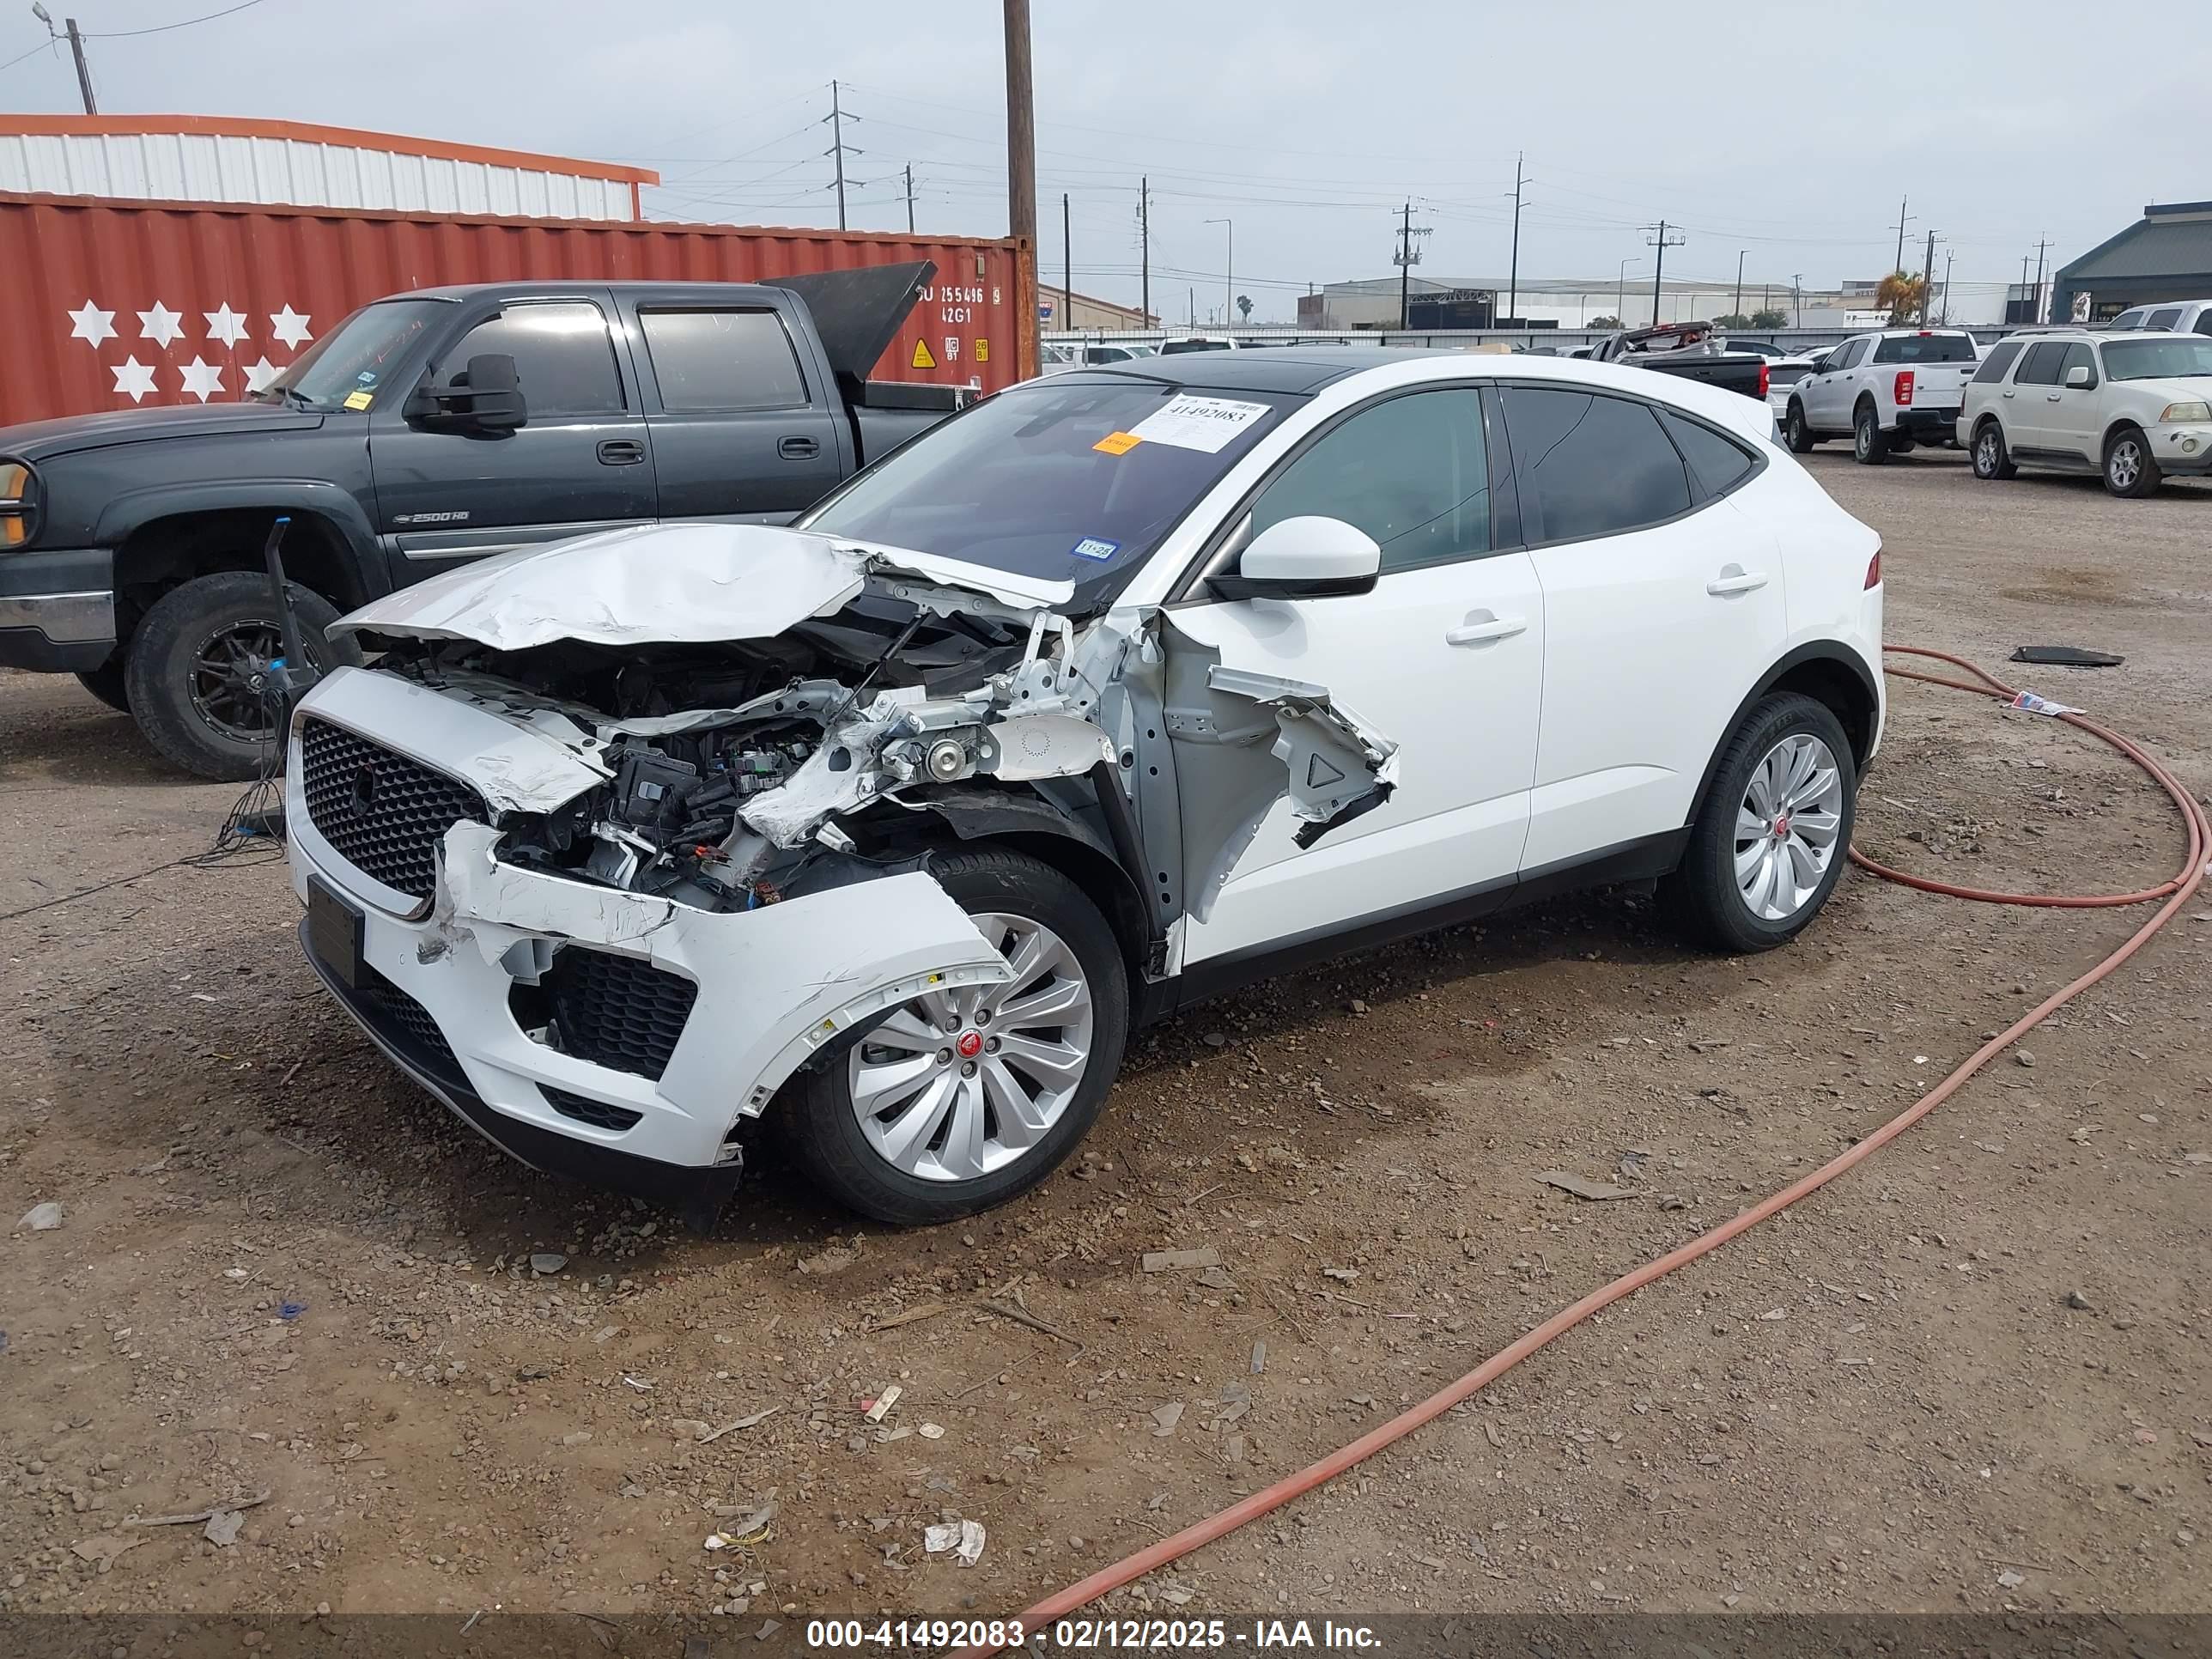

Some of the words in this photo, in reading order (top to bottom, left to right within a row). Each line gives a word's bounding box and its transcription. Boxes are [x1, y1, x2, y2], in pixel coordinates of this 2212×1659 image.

[942, 307, 971, 323] 42G1
[1170, 405, 1247, 422] 41492083
[412, 513, 451, 523] 2500
[452, 511, 470, 520] HD
